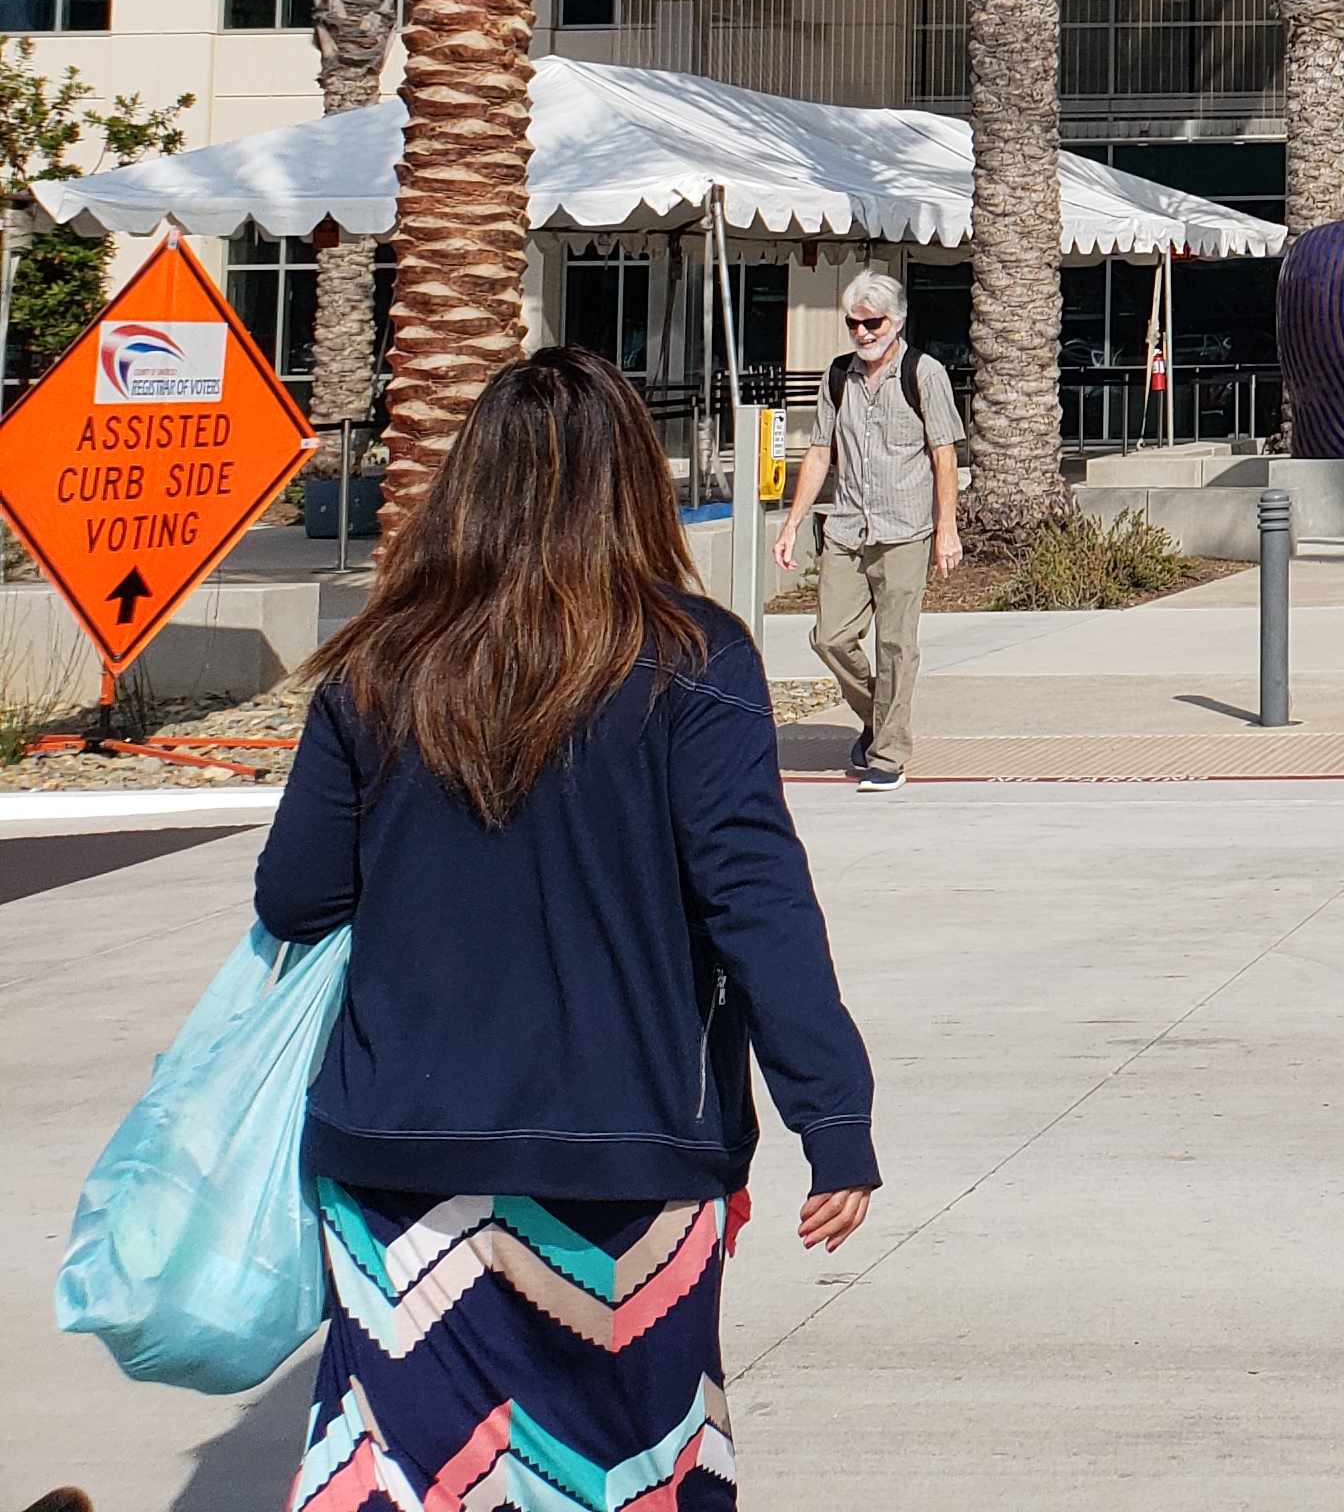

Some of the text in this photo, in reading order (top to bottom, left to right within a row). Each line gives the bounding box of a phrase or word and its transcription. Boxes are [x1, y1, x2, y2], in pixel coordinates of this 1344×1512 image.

[131, 378, 220, 396] REGISTRAR OF VOTERS
[76, 414, 231, 451] ASSISTED
[58, 461, 235, 502] CURB SIDE
[87, 511, 200, 553] VOTING
